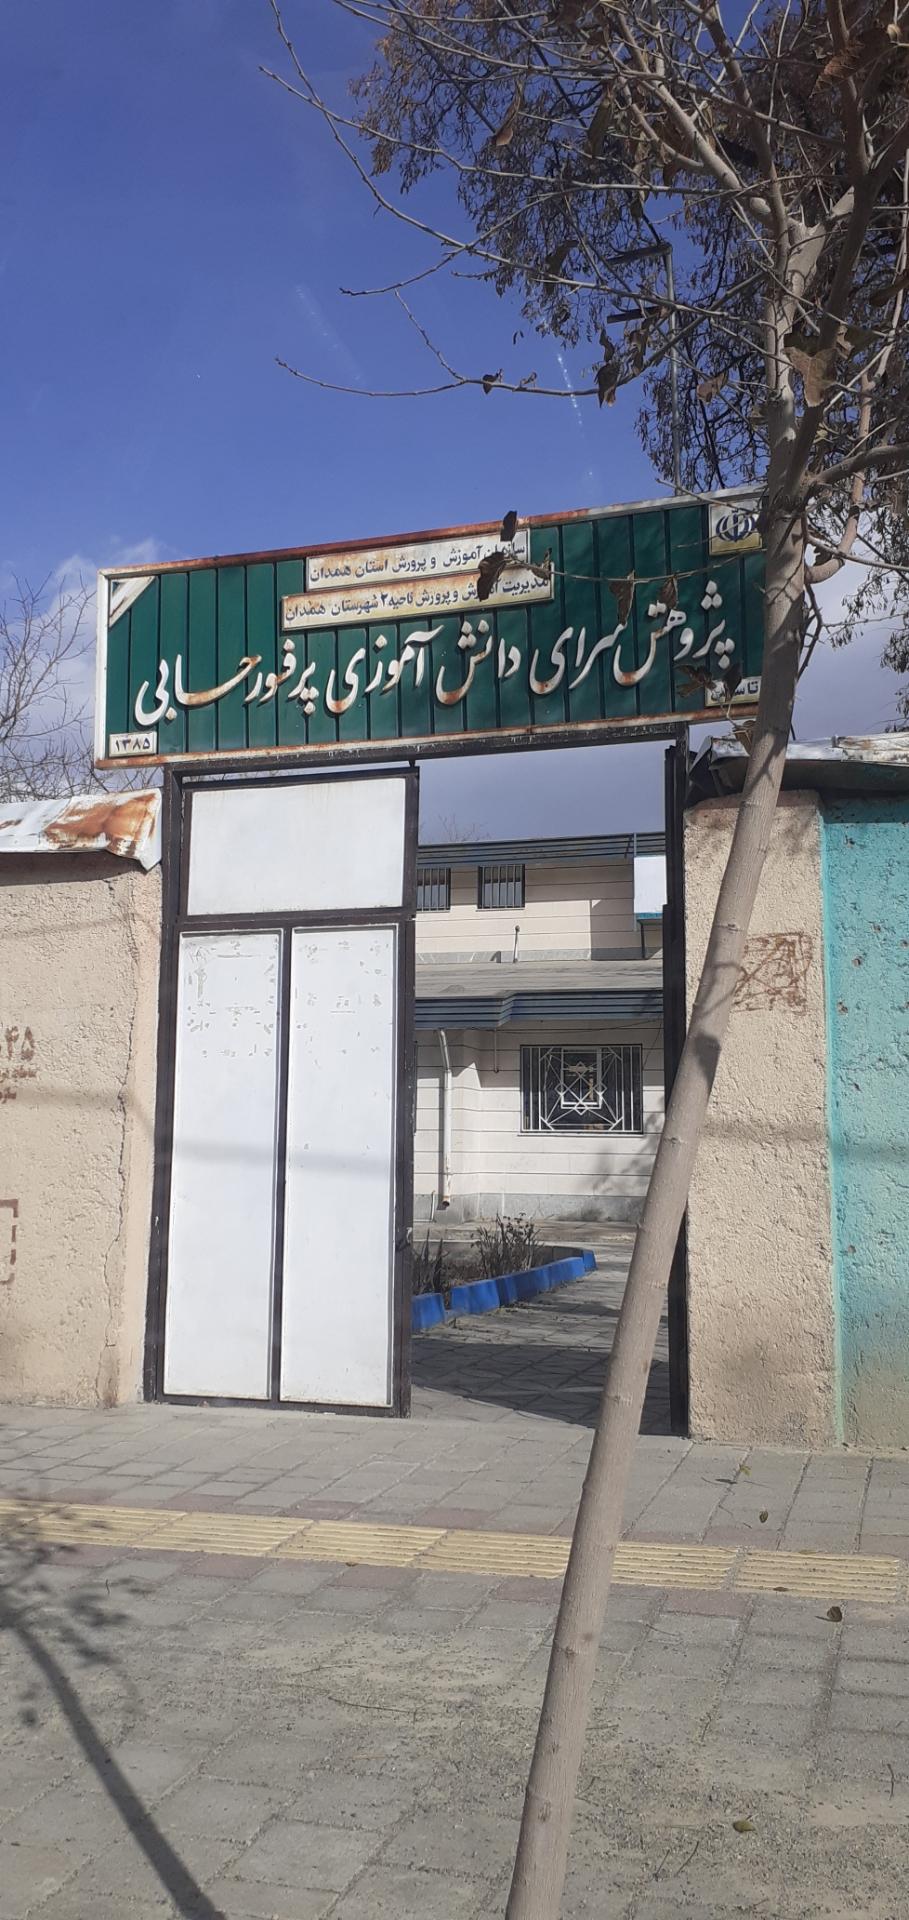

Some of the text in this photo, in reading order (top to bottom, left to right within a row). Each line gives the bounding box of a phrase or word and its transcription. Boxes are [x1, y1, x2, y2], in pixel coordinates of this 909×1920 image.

[392, 554, 427, 573] پرورش
[430, 556, 436, 570] و
[443, 545, 483, 567] آموزش
[310, 565, 352, 582] همدان
[355, 558, 388, 578] استان
[461, 578, 501, 601] آمش
[503, 577, 549, 597] مدیریت
[331, 594, 379, 615] شهرستان
[388, 591, 413, 610] ناحیه
[415, 588, 450, 607] پرورش
[285, 603, 326, 621] همدان
[326, 624, 445, 714] آموزی
[436, 619, 521, 705] دانش
[134, 653, 263, 727] حسابی
[115, 738, 151, 751] ۱۳۸۵
